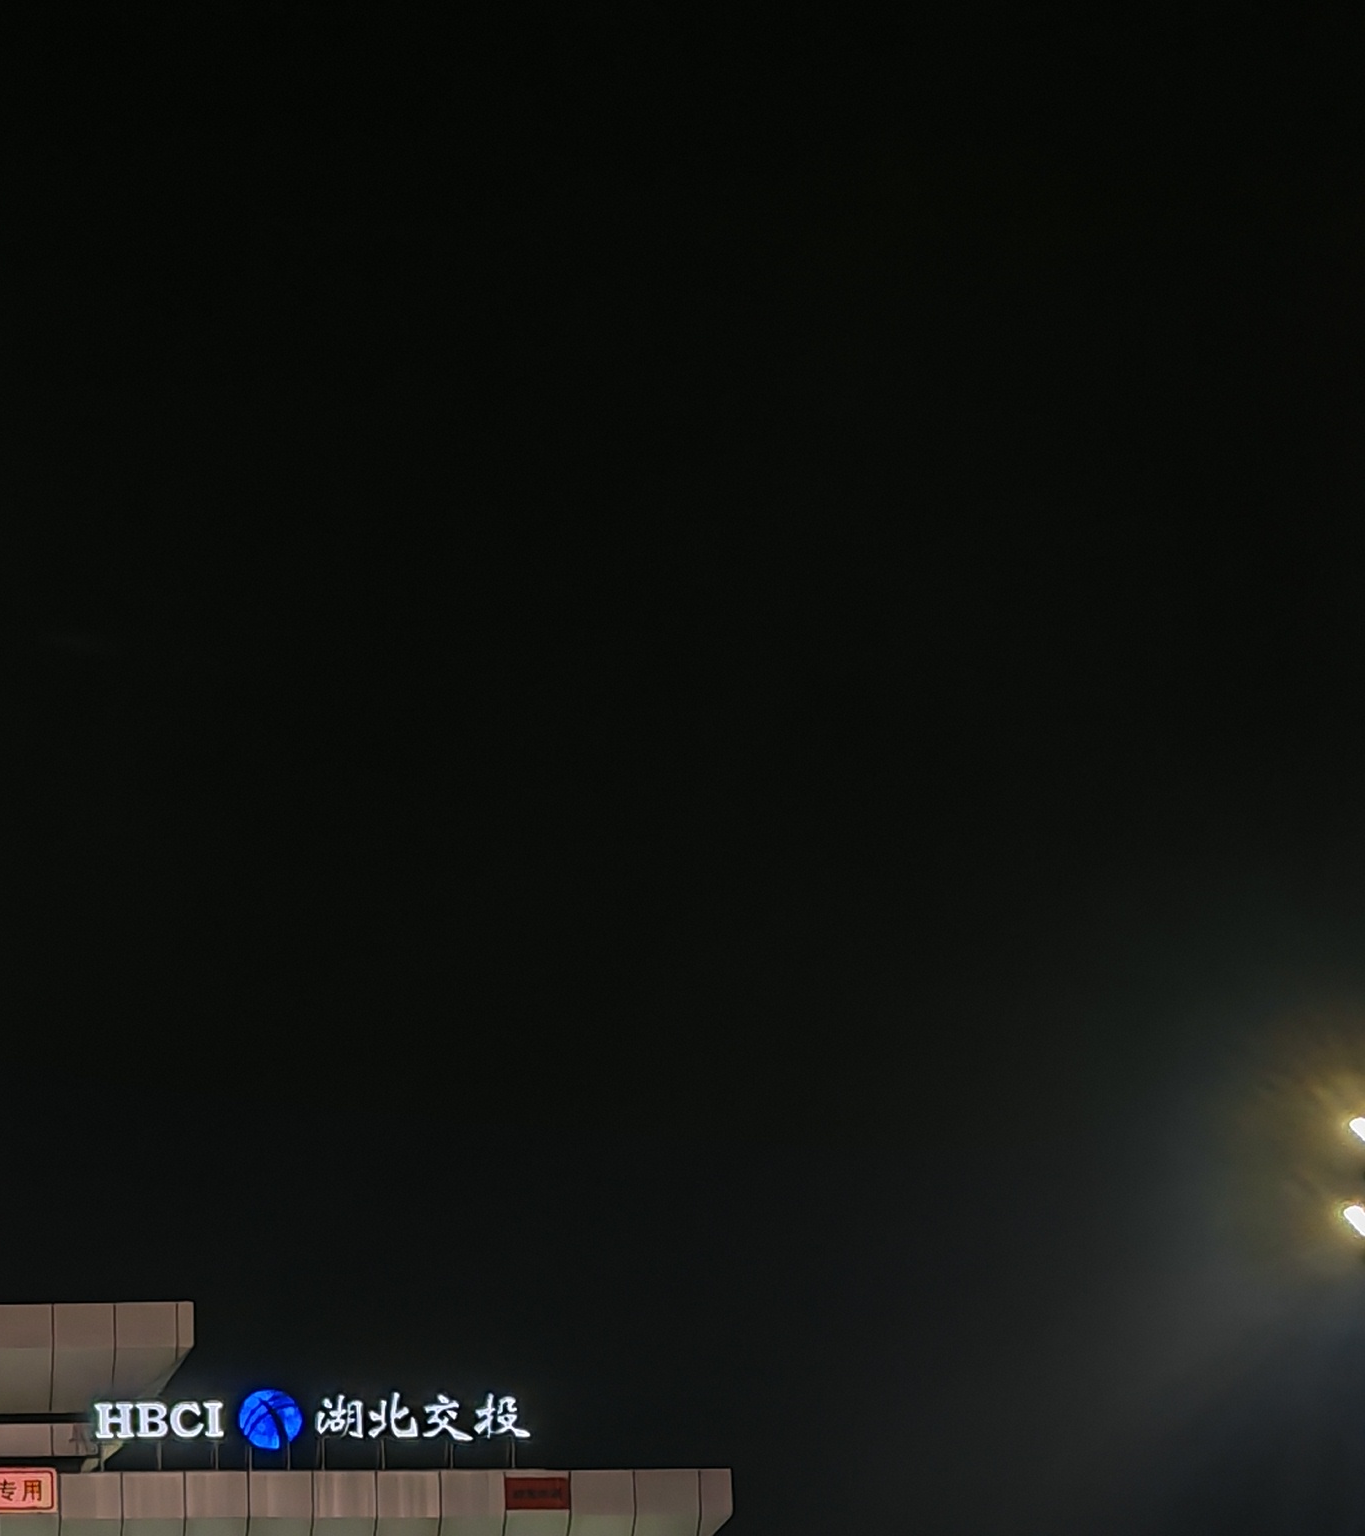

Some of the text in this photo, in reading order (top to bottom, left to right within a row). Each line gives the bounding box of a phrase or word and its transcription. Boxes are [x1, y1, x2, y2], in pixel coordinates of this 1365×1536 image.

[94, 1401, 225, 1440] HBCI
[315, 1394, 532, 1442] 湖北交投
